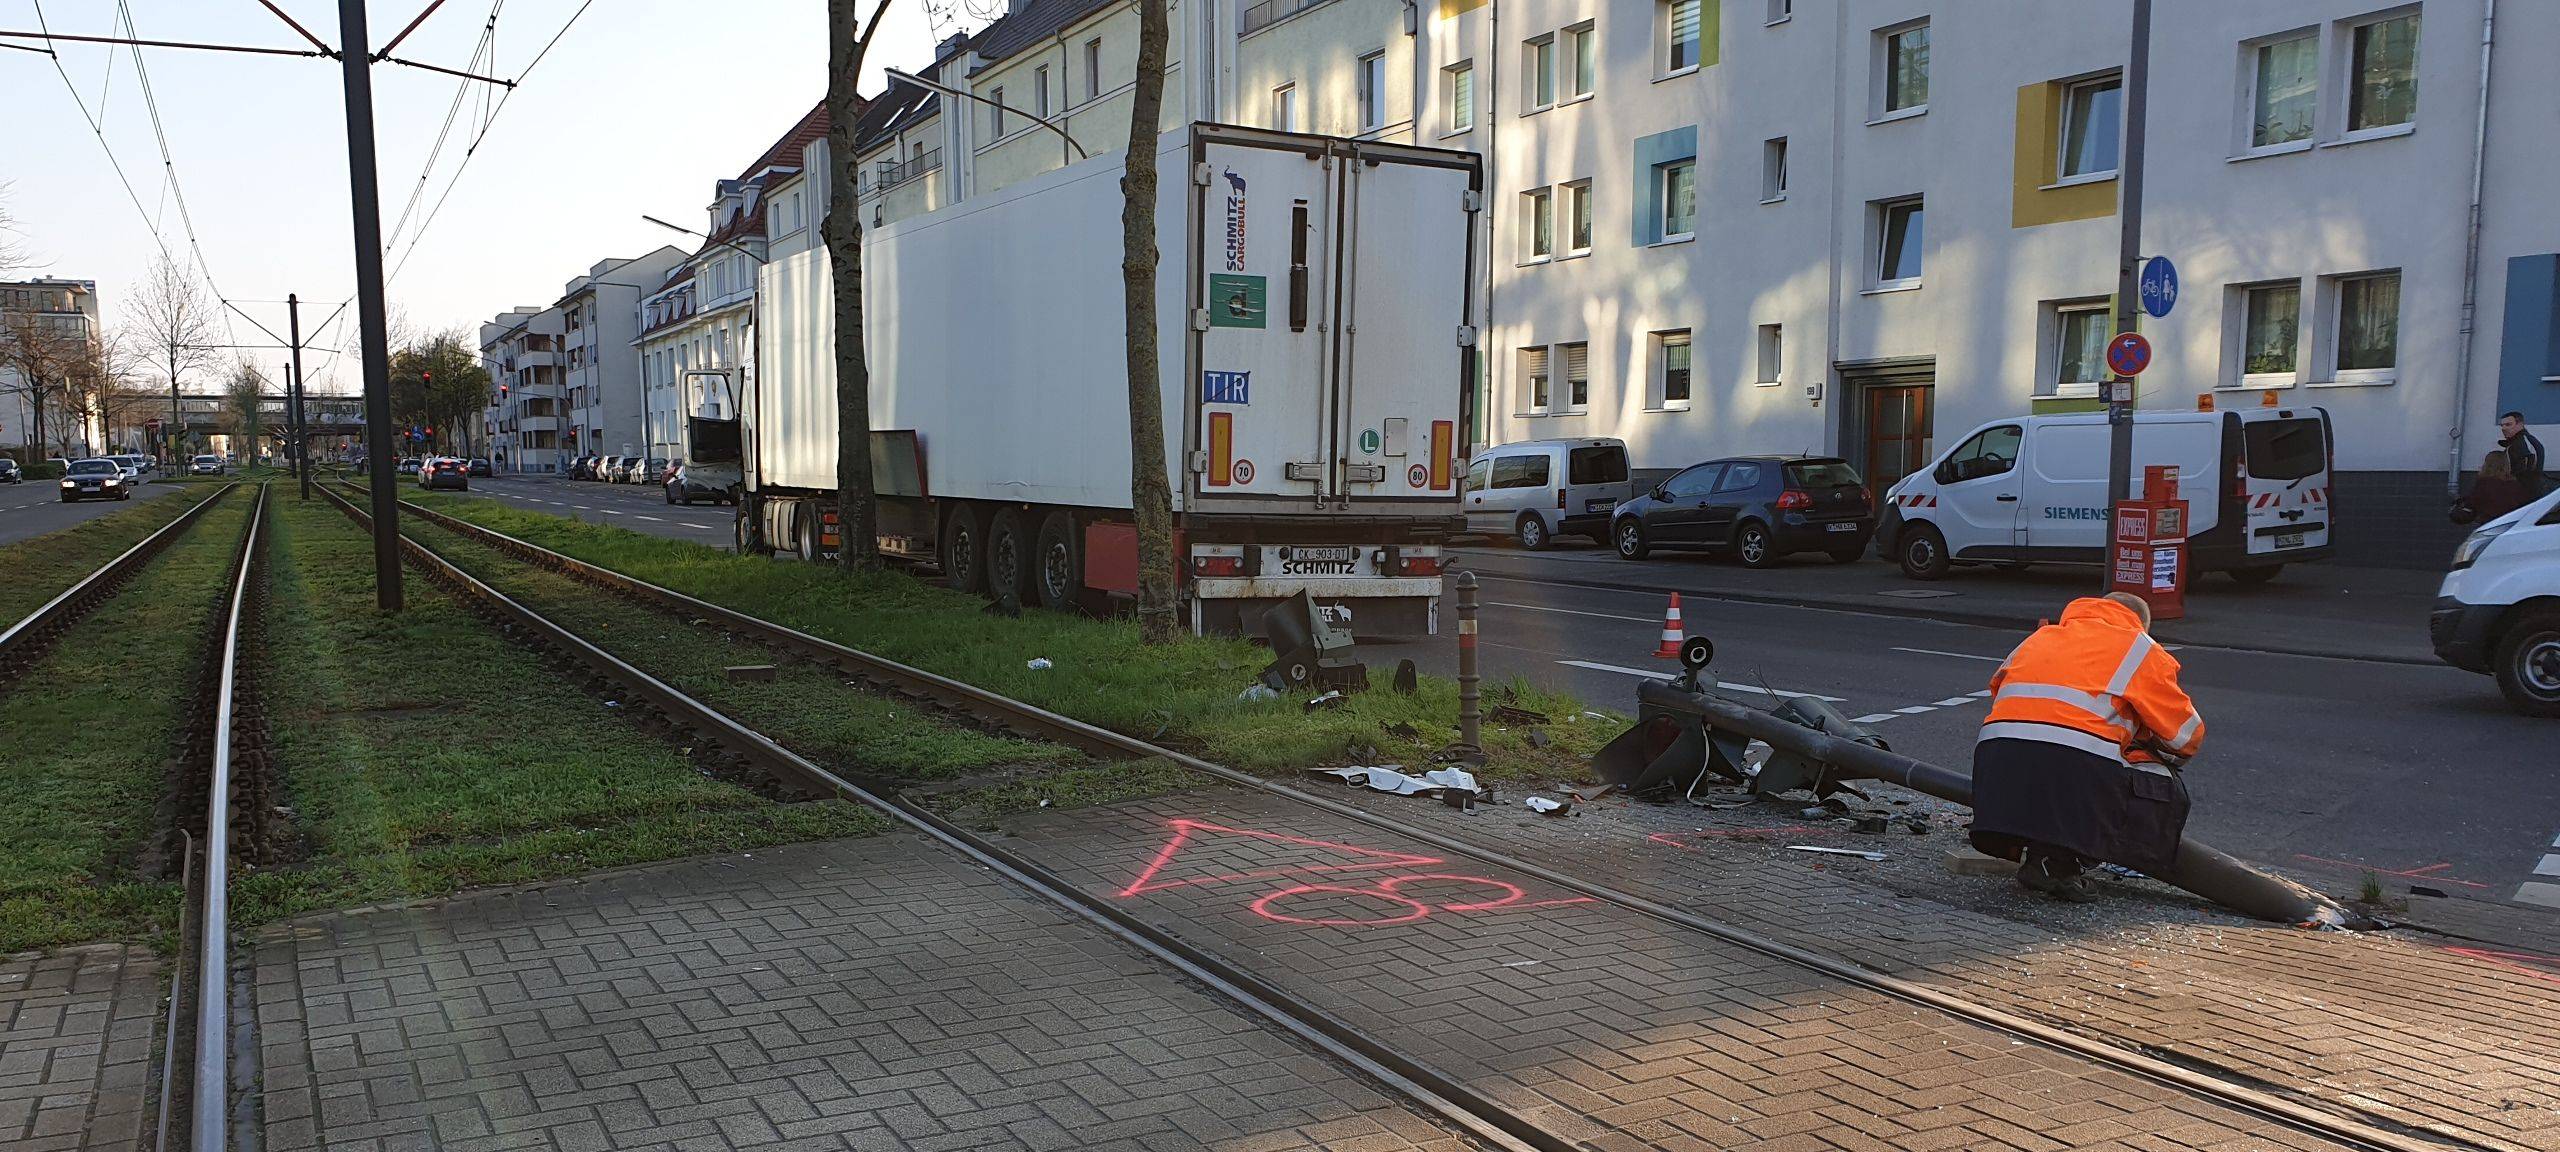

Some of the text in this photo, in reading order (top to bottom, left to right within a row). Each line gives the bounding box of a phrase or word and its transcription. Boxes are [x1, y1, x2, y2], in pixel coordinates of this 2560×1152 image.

[1227, 196, 1237, 271] SCHMITZ
[1237, 197, 1245, 271] CARGOBULL
[1208, 373, 1245, 401] TIR
[1365, 432, 1375, 451] L
[1239, 466, 1249, 477] 70
[1413, 471, 1423, 481] 80
[2044, 507, 2109, 520] SIEMENS
[1282, 562, 1355, 574] SCHMITZ
